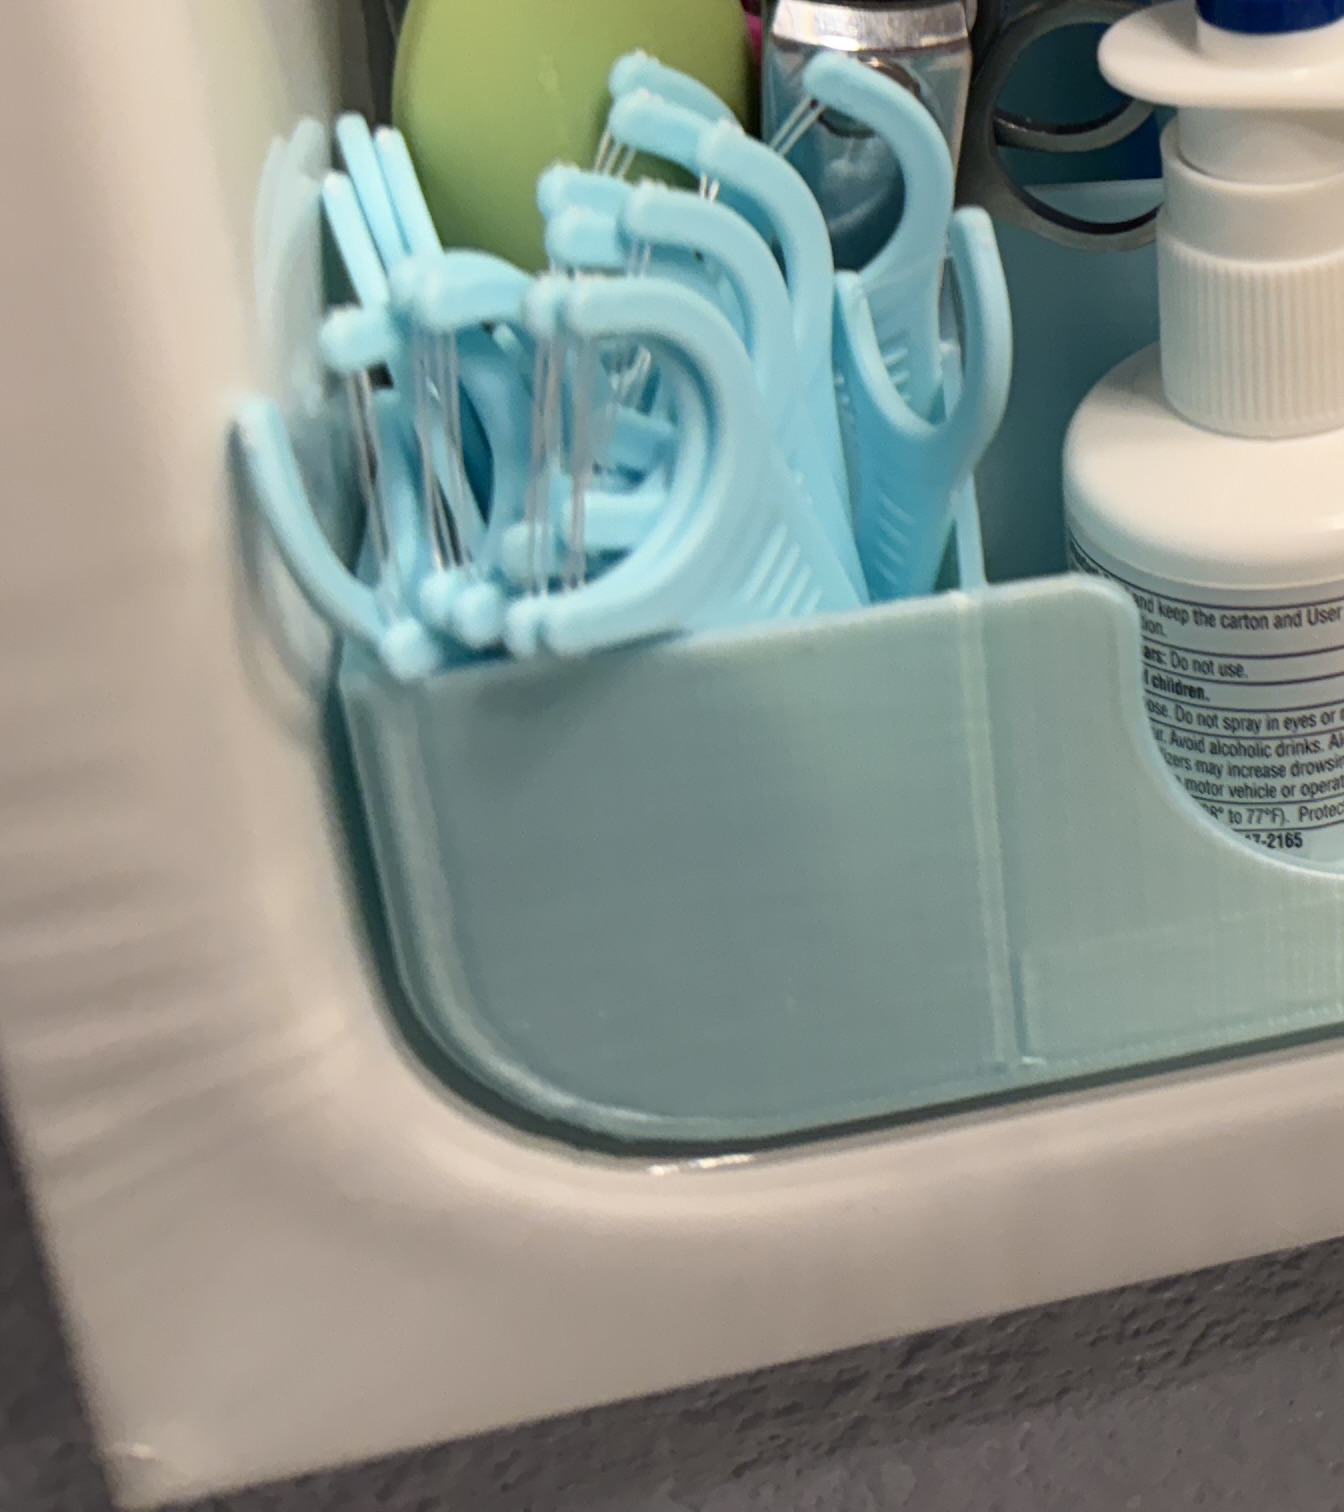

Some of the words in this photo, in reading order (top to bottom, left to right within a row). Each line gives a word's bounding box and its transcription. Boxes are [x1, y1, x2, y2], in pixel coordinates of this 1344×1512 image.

[1158, 599, 1190, 627] keep
[1192, 607, 1217, 628] the
[1219, 613, 1270, 631] carton
[1273, 611, 1303, 630] and
[1307, 605, 1344, 626] User
[1169, 651, 1189, 672] Do
[1192, 659, 1216, 677] not
[1218, 662, 1249, 679] use.
[1151, 672, 1211, 702] children.
[1174, 703, 1194, 725] Do
[1196, 713, 1220, 730] not
[1222, 716, 1263, 736] spray
[1266, 714, 1280, 731] in
[1283, 712, 1317, 734] eyes
[1320, 709, 1337, 725] or
[1170, 728, 1206, 753] Avoid
[1209, 740, 1273, 759] alcoholic
[1275, 738, 1325, 759] drinks.
[1195, 759, 1224, 779] may
[1226, 761, 1287, 779] increase
[1183, 776, 1225, 798] motor
[1227, 781, 1278, 799] vehicle
[1280, 782, 1297, 798] or
[1228, 807, 1243, 825] to
